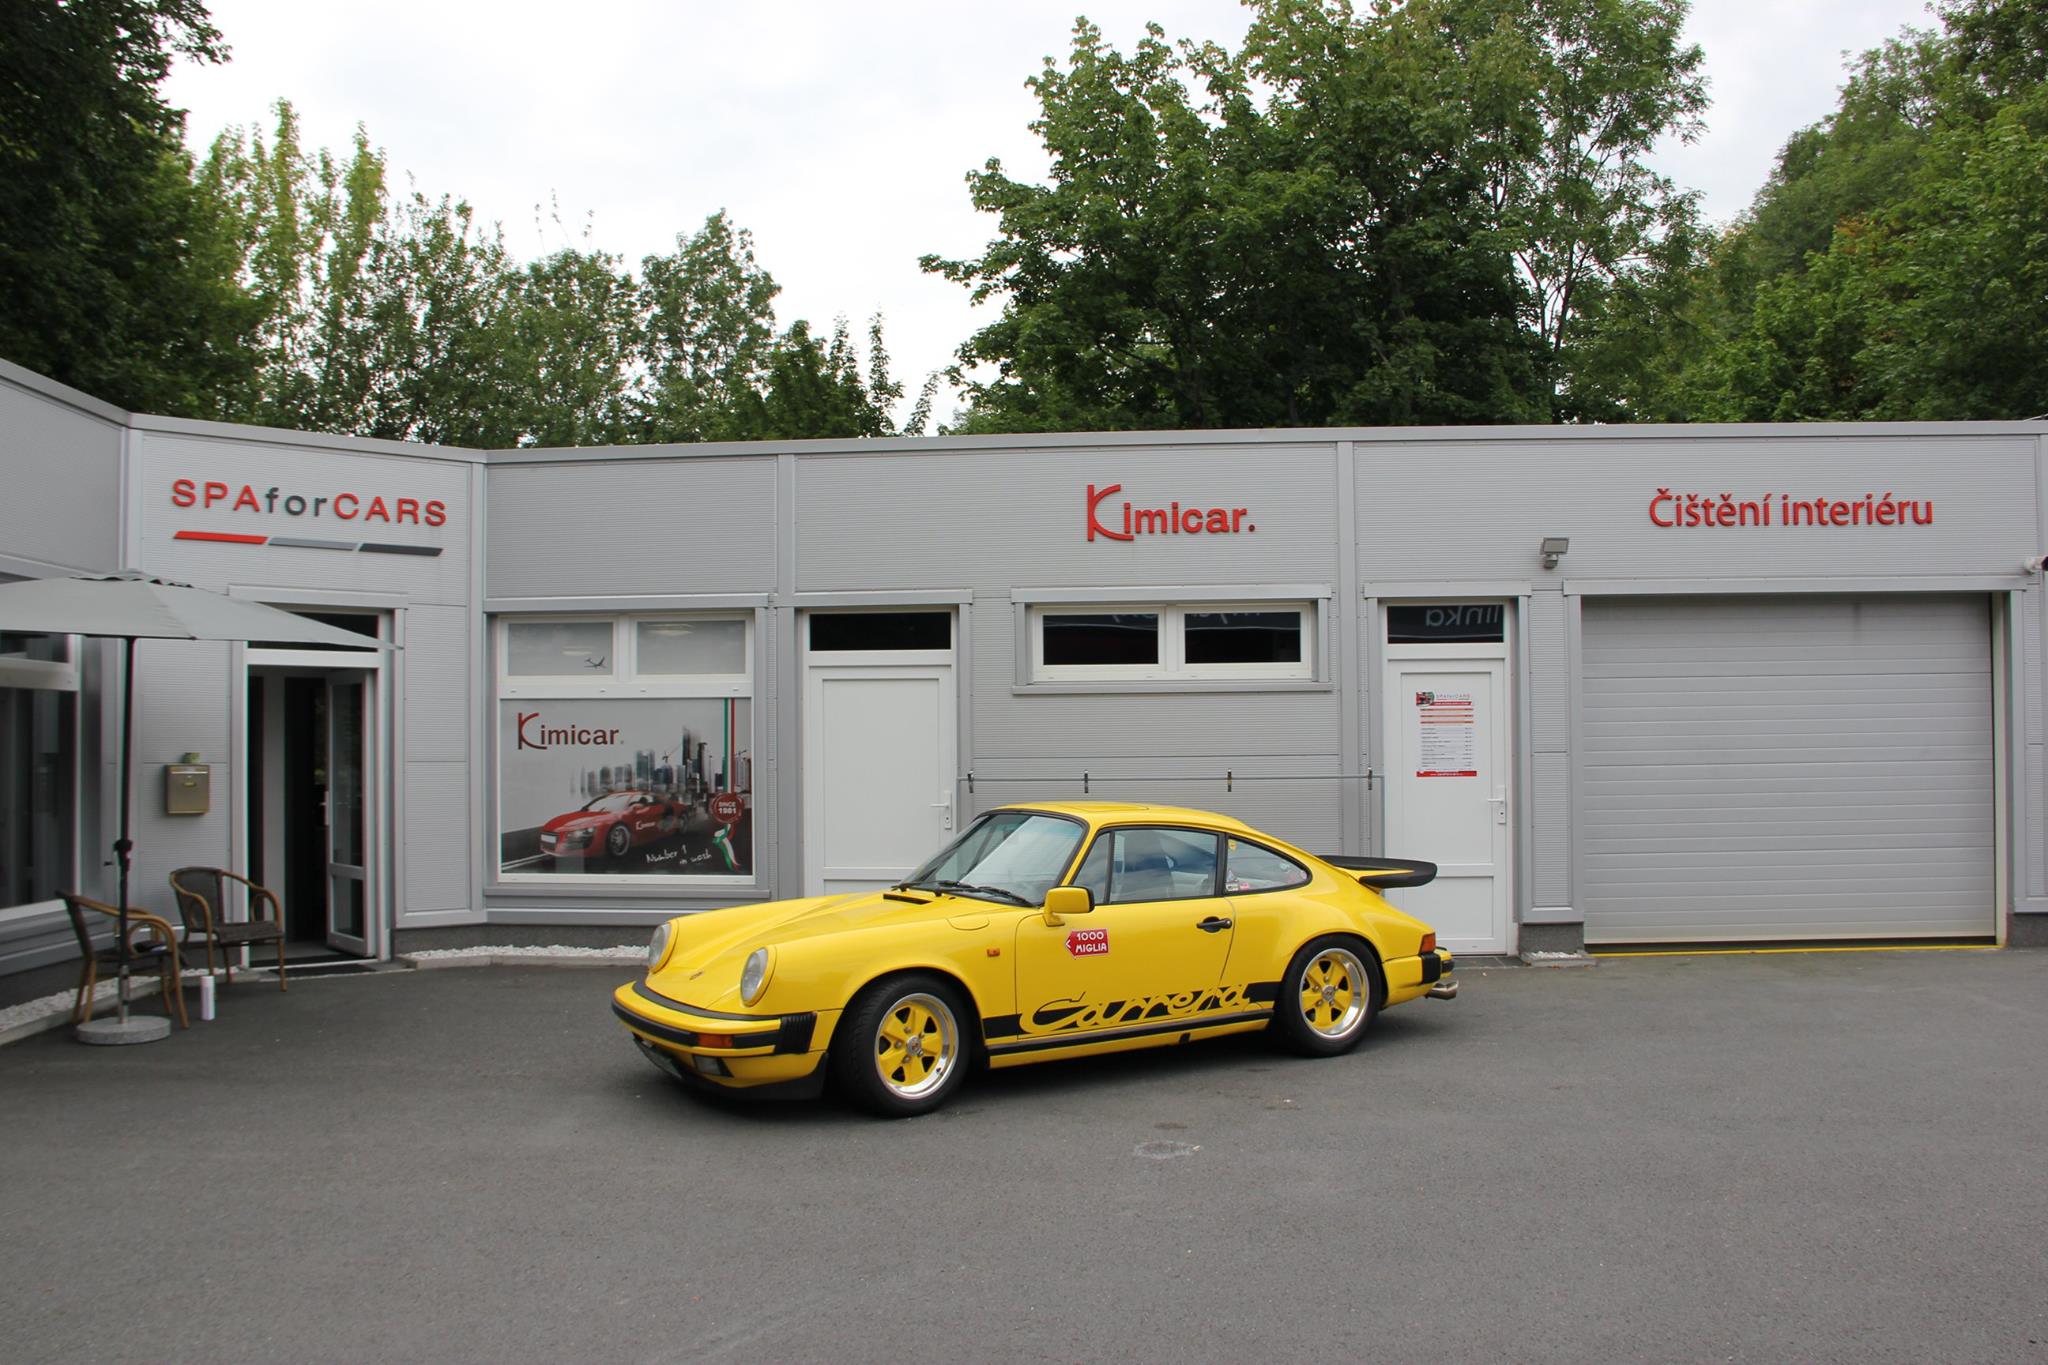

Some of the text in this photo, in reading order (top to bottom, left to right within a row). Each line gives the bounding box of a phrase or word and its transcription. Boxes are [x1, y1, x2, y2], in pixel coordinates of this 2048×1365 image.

[171, 478, 447, 527] SPAforCARS
[1649, 488, 1934, 528] Čištění interiéru
[1075, 942, 1107, 953] MIGLIA
[1076, 931, 1105, 942] 1000
[1019, 983, 1252, 1034] Carrera
